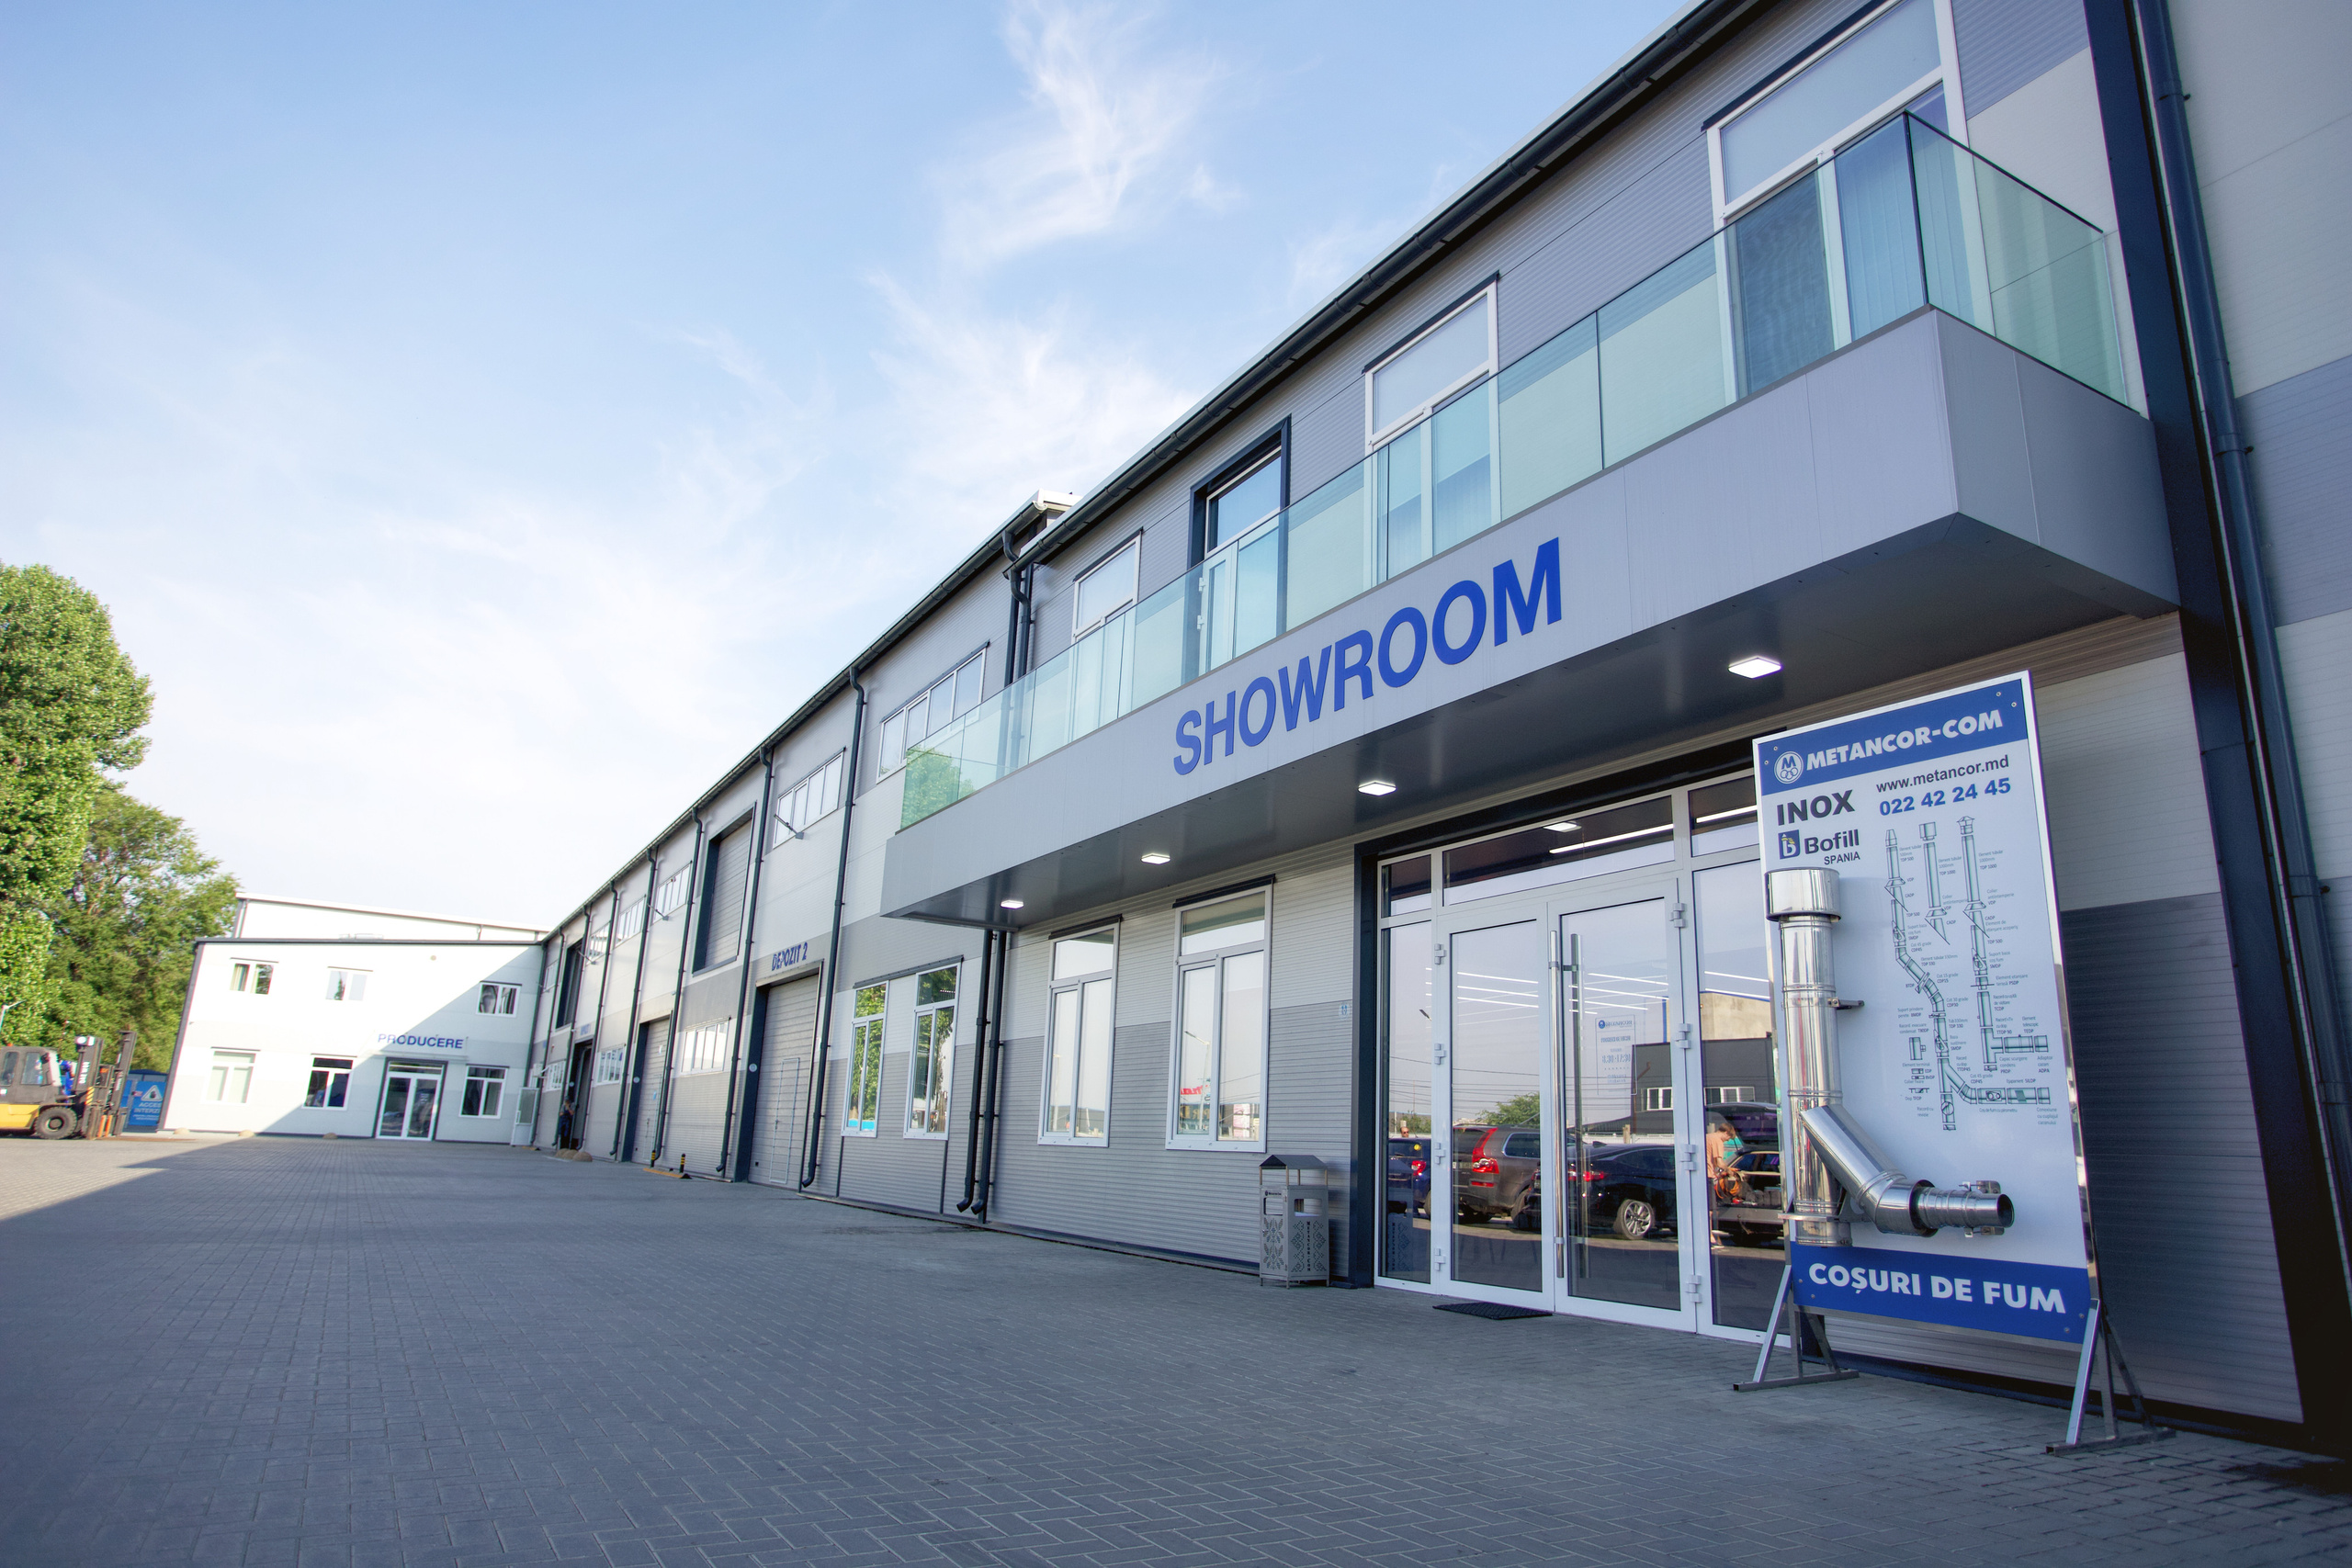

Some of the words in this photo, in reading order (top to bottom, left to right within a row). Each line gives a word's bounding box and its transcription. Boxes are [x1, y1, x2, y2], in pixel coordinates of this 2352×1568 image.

[1173, 536, 1562, 775] SHOWROOM
[1806, 709, 2003, 771] METANCOR-COM
[1876, 754, 2009, 793] www.metancor.md
[1777, 789, 1856, 826] INOX
[1879, 795, 1915, 816] 022
[1920, 790, 1946, 807] 42
[1951, 784, 1978, 803] 24
[1984, 777, 2011, 795] 45
[1804, 829, 1860, 854] Bofill
[1824, 851, 1860, 865] SPANIA
[772, 944, 802, 971] DEPOZIT
[802, 942, 808, 961] 2
[378, 1033, 464, 1049] PRODUCERE
[1808, 1262, 1921, 1294] COȘURI
[1930, 1275, 1973, 1303] DE
[1983, 1280, 2066, 1314] FUM
